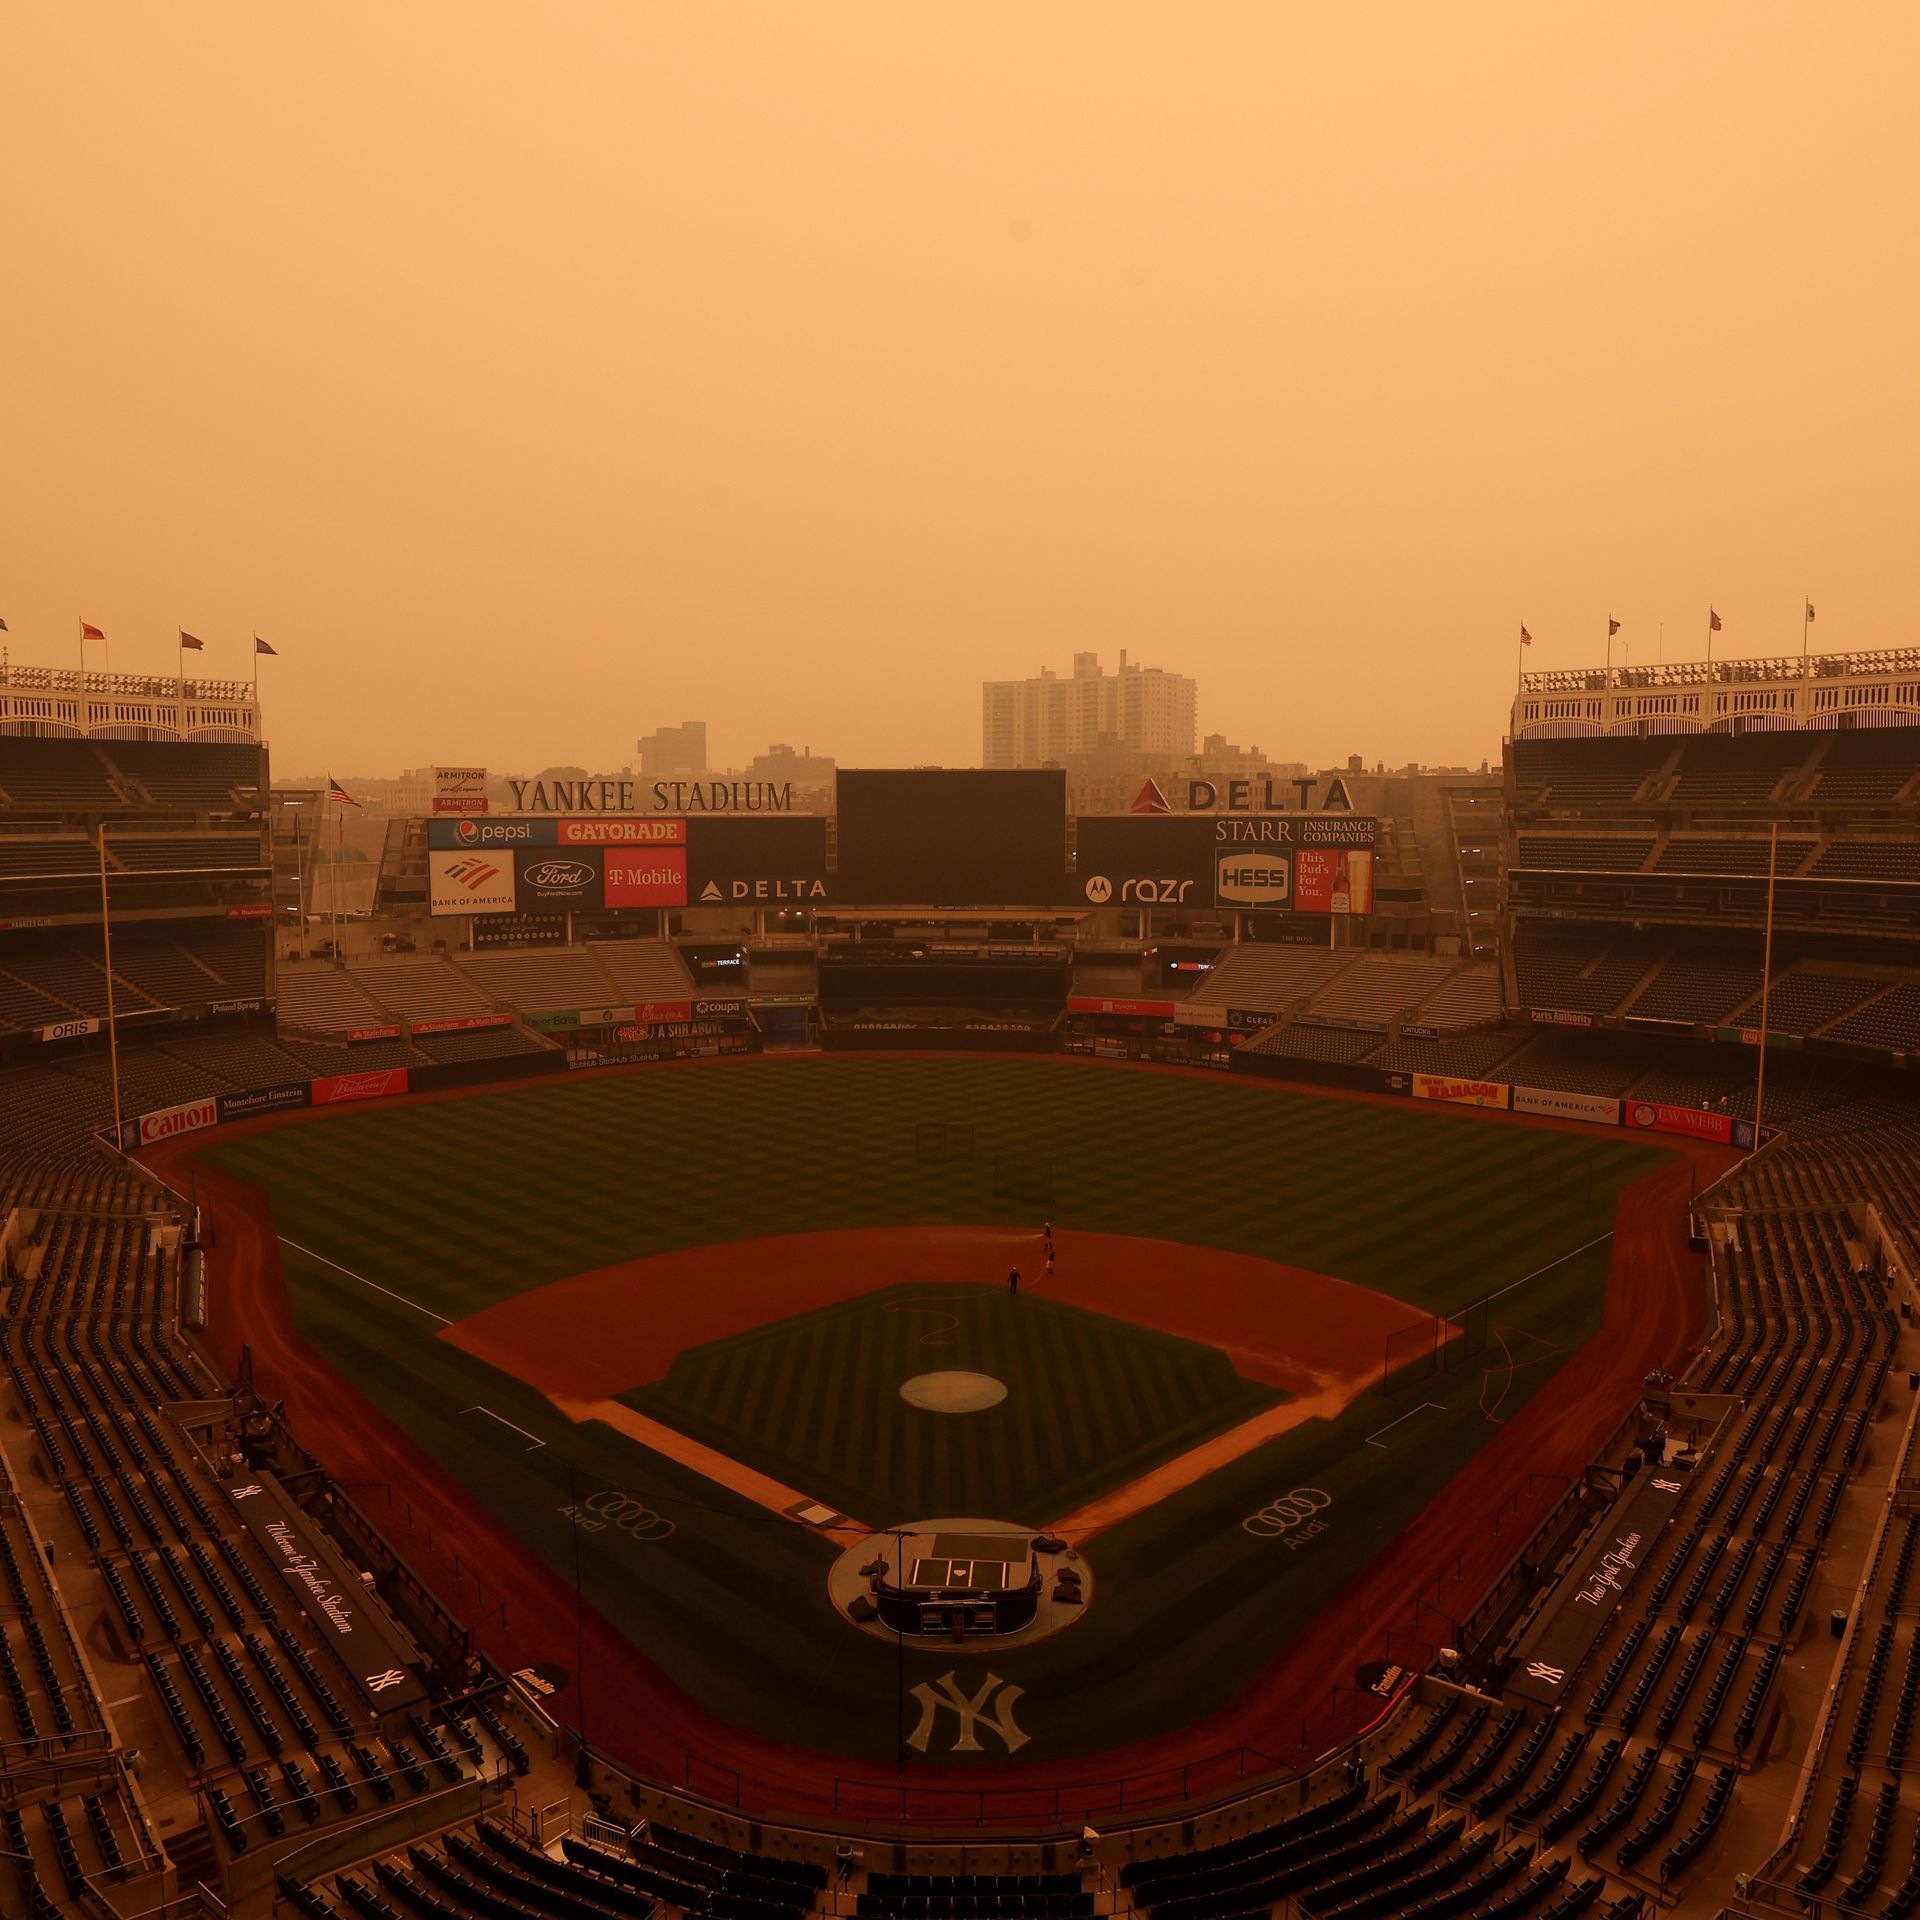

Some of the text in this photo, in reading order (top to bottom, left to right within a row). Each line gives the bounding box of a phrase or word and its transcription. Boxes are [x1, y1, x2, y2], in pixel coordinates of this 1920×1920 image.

[437, 772, 485, 780] ARMITRON
[440, 799, 483, 807] ARMITRON
[508, 781, 792, 811] YANKEE STADIUM
[1188, 779, 1354, 810] DELTA
[482, 823, 530, 842] pepsi
[567, 823, 678, 841] GATORADE
[1215, 820, 1295, 842] STARR
[1303, 821, 1375, 832] INSURANCE
[1303, 832, 1375, 843] COMPANIES
[1298, 852, 1325, 863] This
[536, 864, 583, 884] Ford
[627, 869, 682, 885] Mobile
[1223, 868, 1284, 888] HESS
[1299, 863, 1329, 875] Bud's
[732, 879, 827, 898] DELTA
[1298, 874, 1318, 885] For
[1121, 879, 1194, 903] razr
[1298, 886, 1323, 897] You.
[432, 896, 513, 907] BANK OF AMERICA
[212, 1001, 260, 1015] Poland Spring
[709, 1002, 740, 1014] coupa
[1531, 1010, 1592, 1024] Parts Authority
[1245, 1016, 1274, 1025] CLEAR
[53, 1021, 88, 1039] ORIS
[569, 1059, 596, 1070] StubHub
[630, 1054, 659, 1063] StubHub
[336, 1079, 388, 1094] Budweiser
[223, 1095, 268, 1111] Montefiore
[268, 1088, 303, 1101] Einstein
[1515, 1095, 1596, 1113] BANK OF AMERICA
[141, 1103, 216, 1139] Canon
[1686, 1112, 1722, 1130] WEBB
[556, 1503, 608, 1533] Audi
[1282, 1519, 1330, 1551] Audi
[265, 1520, 353, 1634] Welcome to Yankee Stadium
[1575, 1531, 1641, 1606] New York Yankees
[365, 1669, 406, 1692] NY
[511, 1667, 556, 1695] Franklin
[1370, 1665, 1403, 1698] Franklin
[1526, 1661, 1566, 1685] NY
[905, 1669, 1032, 1754] NY
